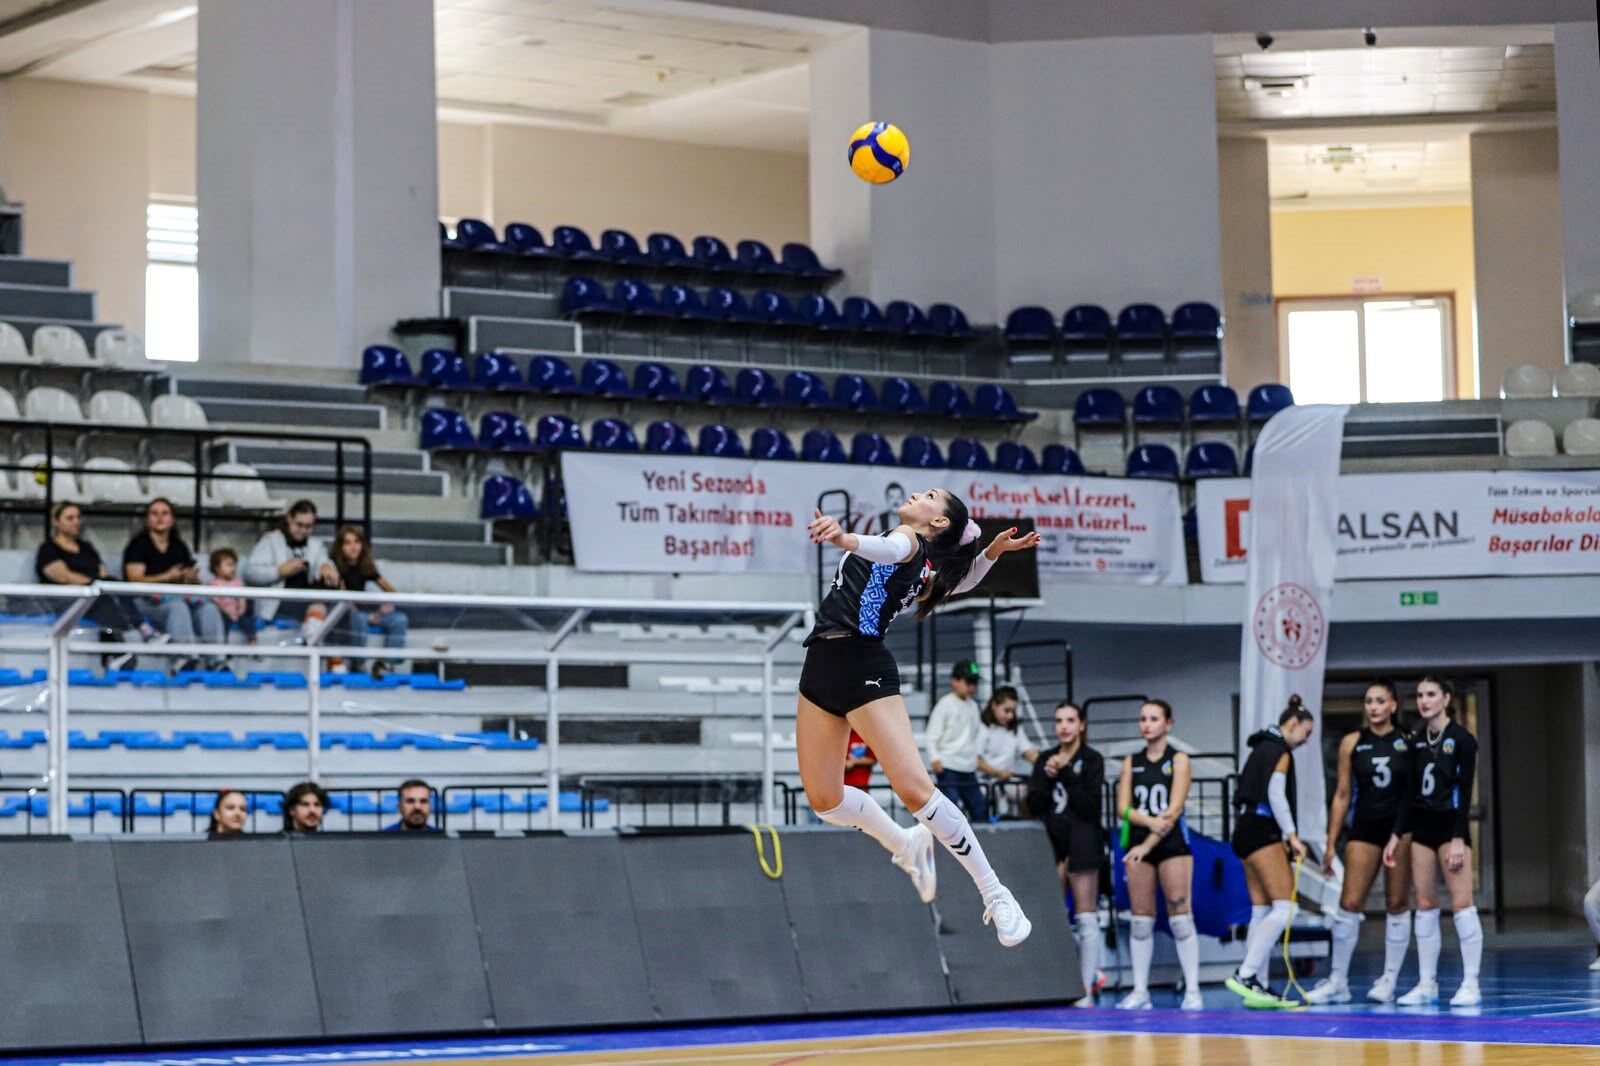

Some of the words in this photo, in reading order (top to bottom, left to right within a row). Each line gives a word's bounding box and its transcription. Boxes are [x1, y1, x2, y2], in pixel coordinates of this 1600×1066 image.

[643, 470, 686, 492] Yeni
[691, 471, 766, 495] Sezonda
[617, 500, 660, 522] Tüm
[665, 501, 794, 527] Takımlarınıza
[1488, 533, 1575, 558] Başarılar
[1371, 756, 1392, 788] 3
[1421, 762, 1436, 796] 6
[1052, 782, 1068, 814] 9
[1134, 783, 1168, 815] 20
